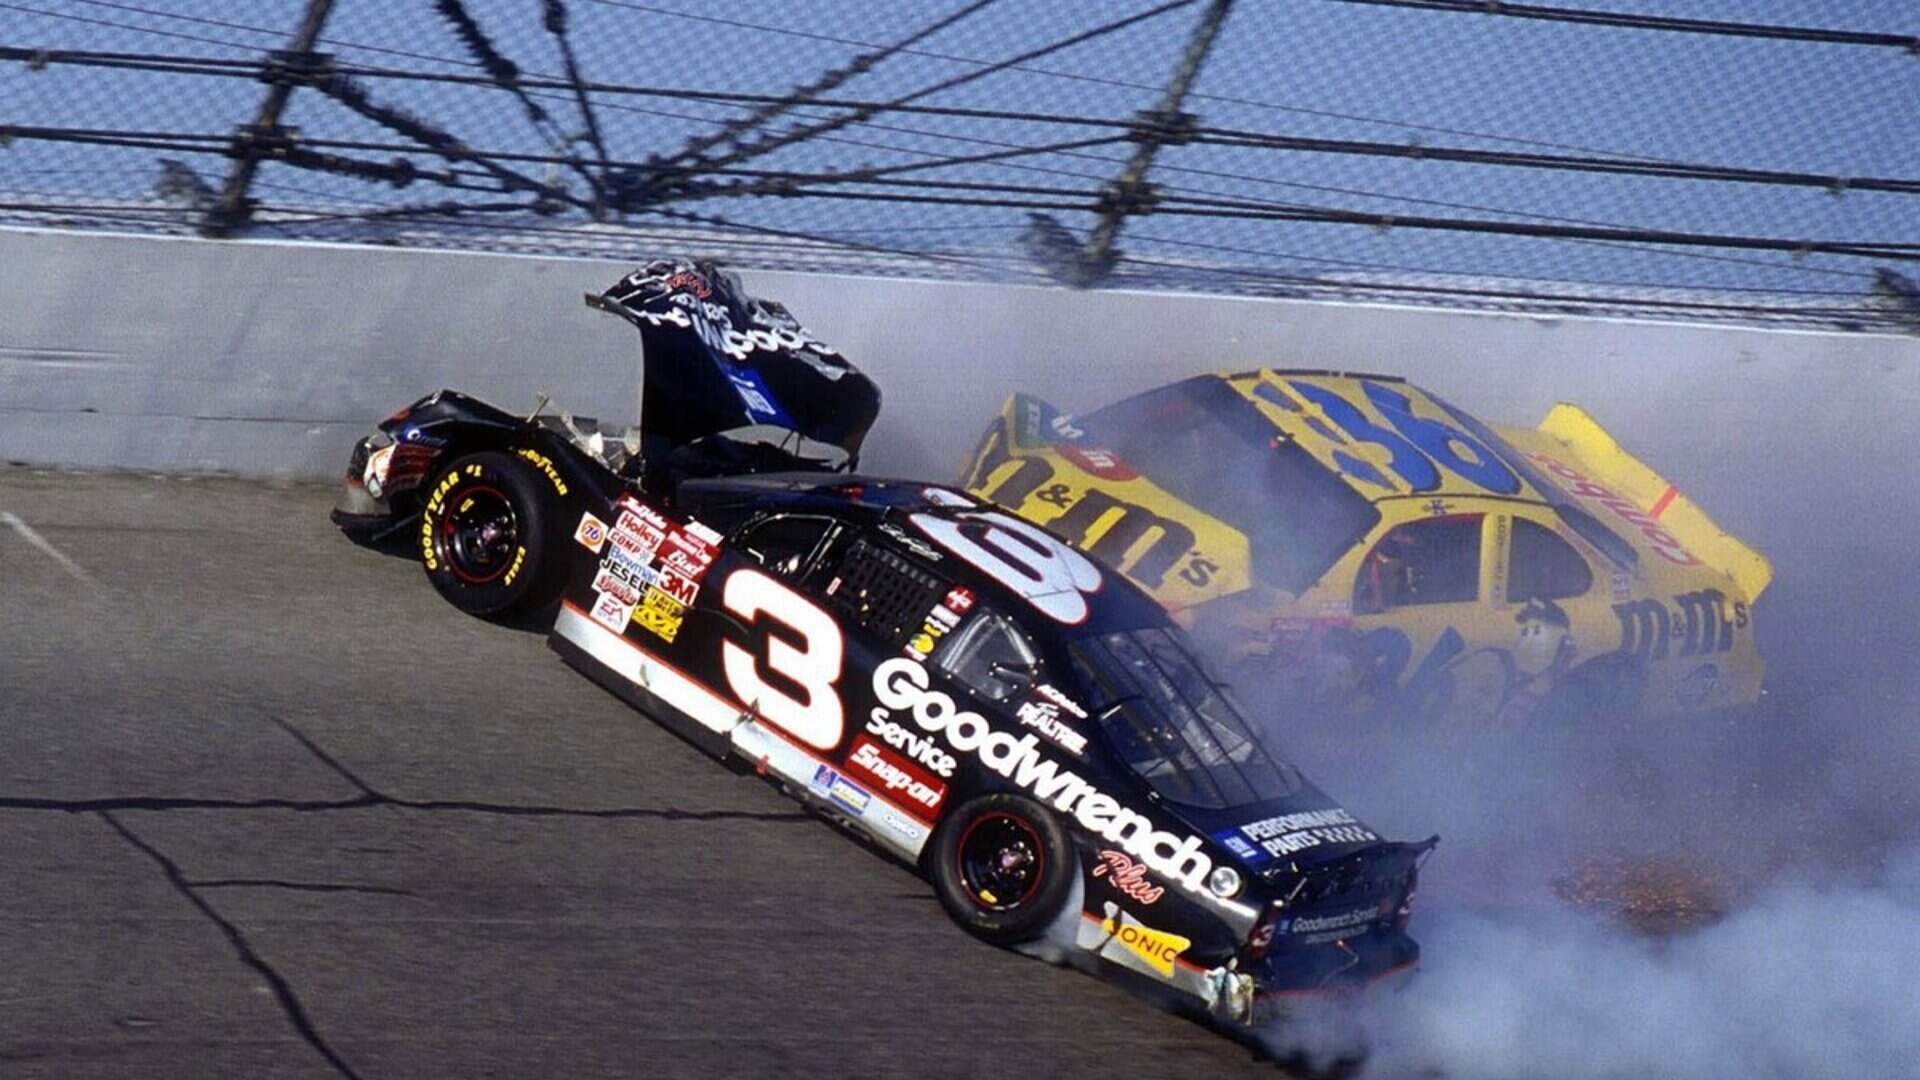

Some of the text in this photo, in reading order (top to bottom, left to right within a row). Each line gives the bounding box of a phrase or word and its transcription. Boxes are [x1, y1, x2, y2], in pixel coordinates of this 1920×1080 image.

[1252, 379, 1522, 495] 36
[422, 471, 460, 570] GOODYEAR
[585, 525, 600, 540] 76
[621, 514, 661, 550] Holley
[610, 532, 642, 555] COMP
[908, 487, 1102, 624] 3
[601, 558, 650, 593] JESEL
[610, 545, 659, 584] Bowman
[660, 570, 696, 607] 3M
[723, 568, 843, 750] 3
[867, 707, 957, 778] Service
[851, 742, 941, 808] Snap-on
[873, 657, 1214, 892] Goodwrench
[1240, 808, 1356, 842] PERFORMANCE
[1261, 830, 1321, 858] PARTS
[1094, 850, 1164, 904] Plus
[1109, 926, 1177, 962] ONIC
